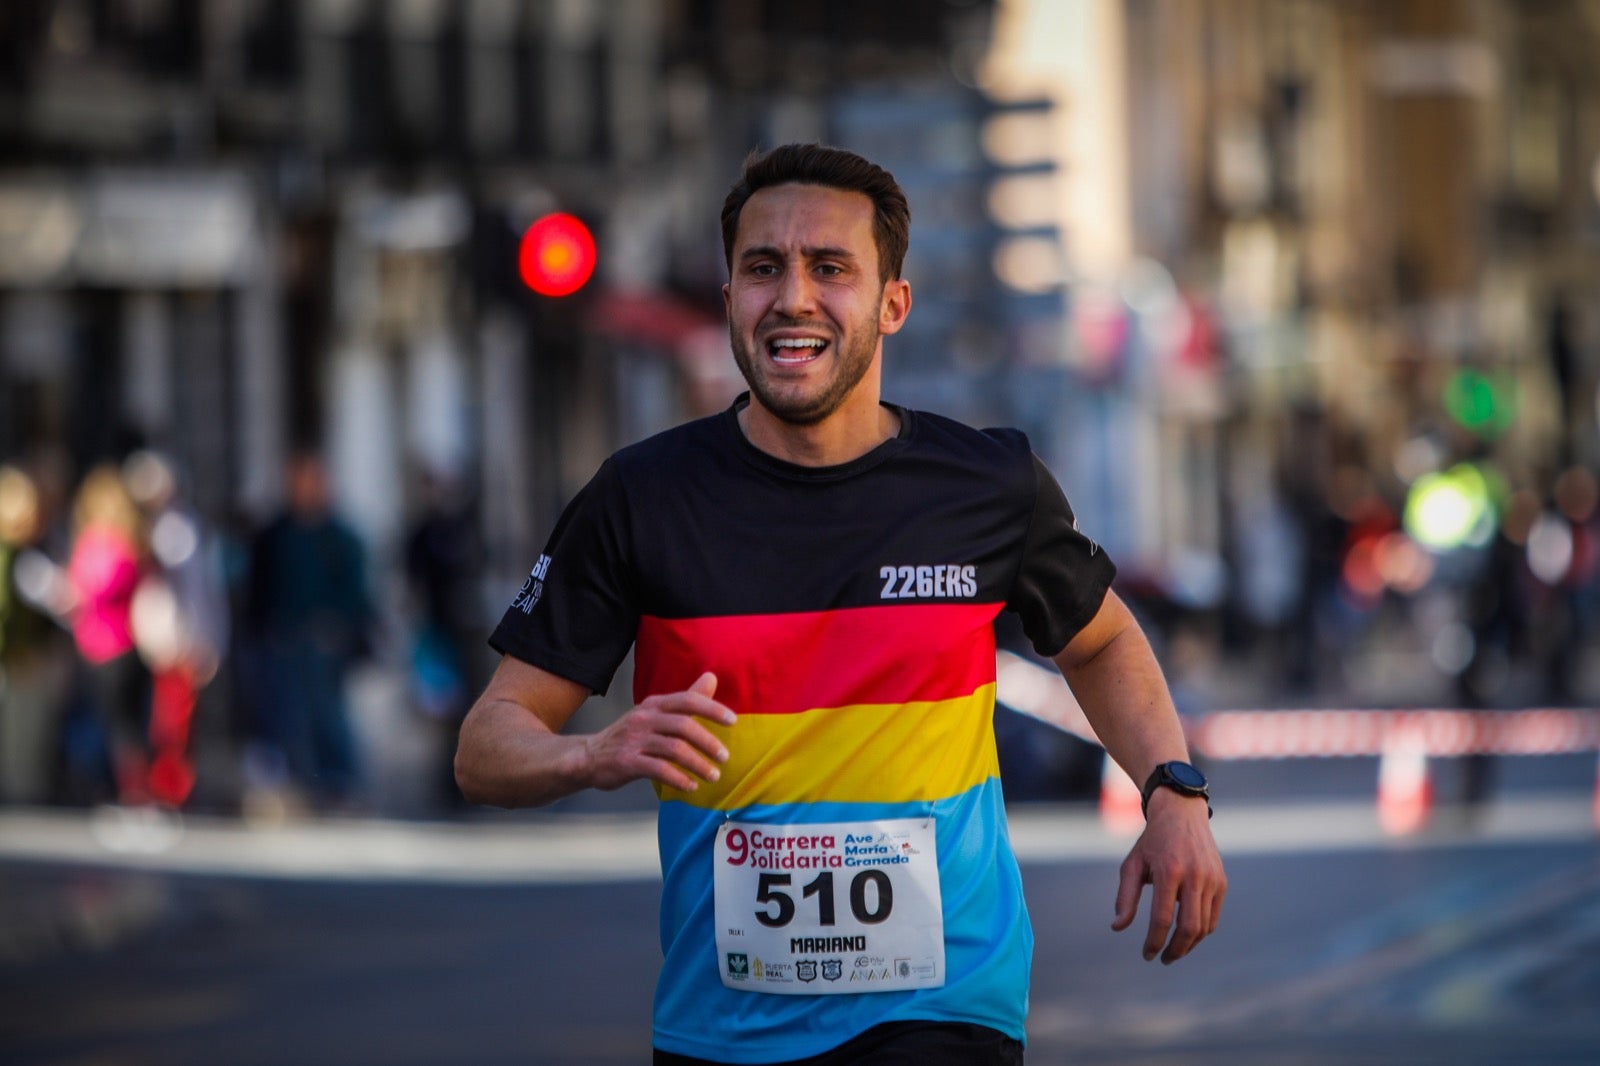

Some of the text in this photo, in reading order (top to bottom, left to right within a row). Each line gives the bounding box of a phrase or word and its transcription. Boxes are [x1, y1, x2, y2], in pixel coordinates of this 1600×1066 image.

[880, 565, 977, 599] 226ERS
[726, 828, 749, 866] 9
[750, 830, 835, 850] Carrera
[845, 834, 873, 844] Ave
[750, 850, 842, 869] Solidaria
[845, 844, 888, 856] María
[845, 854, 909, 867] Granada
[754, 869, 894, 928] 510
[790, 935, 866, 954] MARIANO
[765, 963, 793, 971] PUERTA
